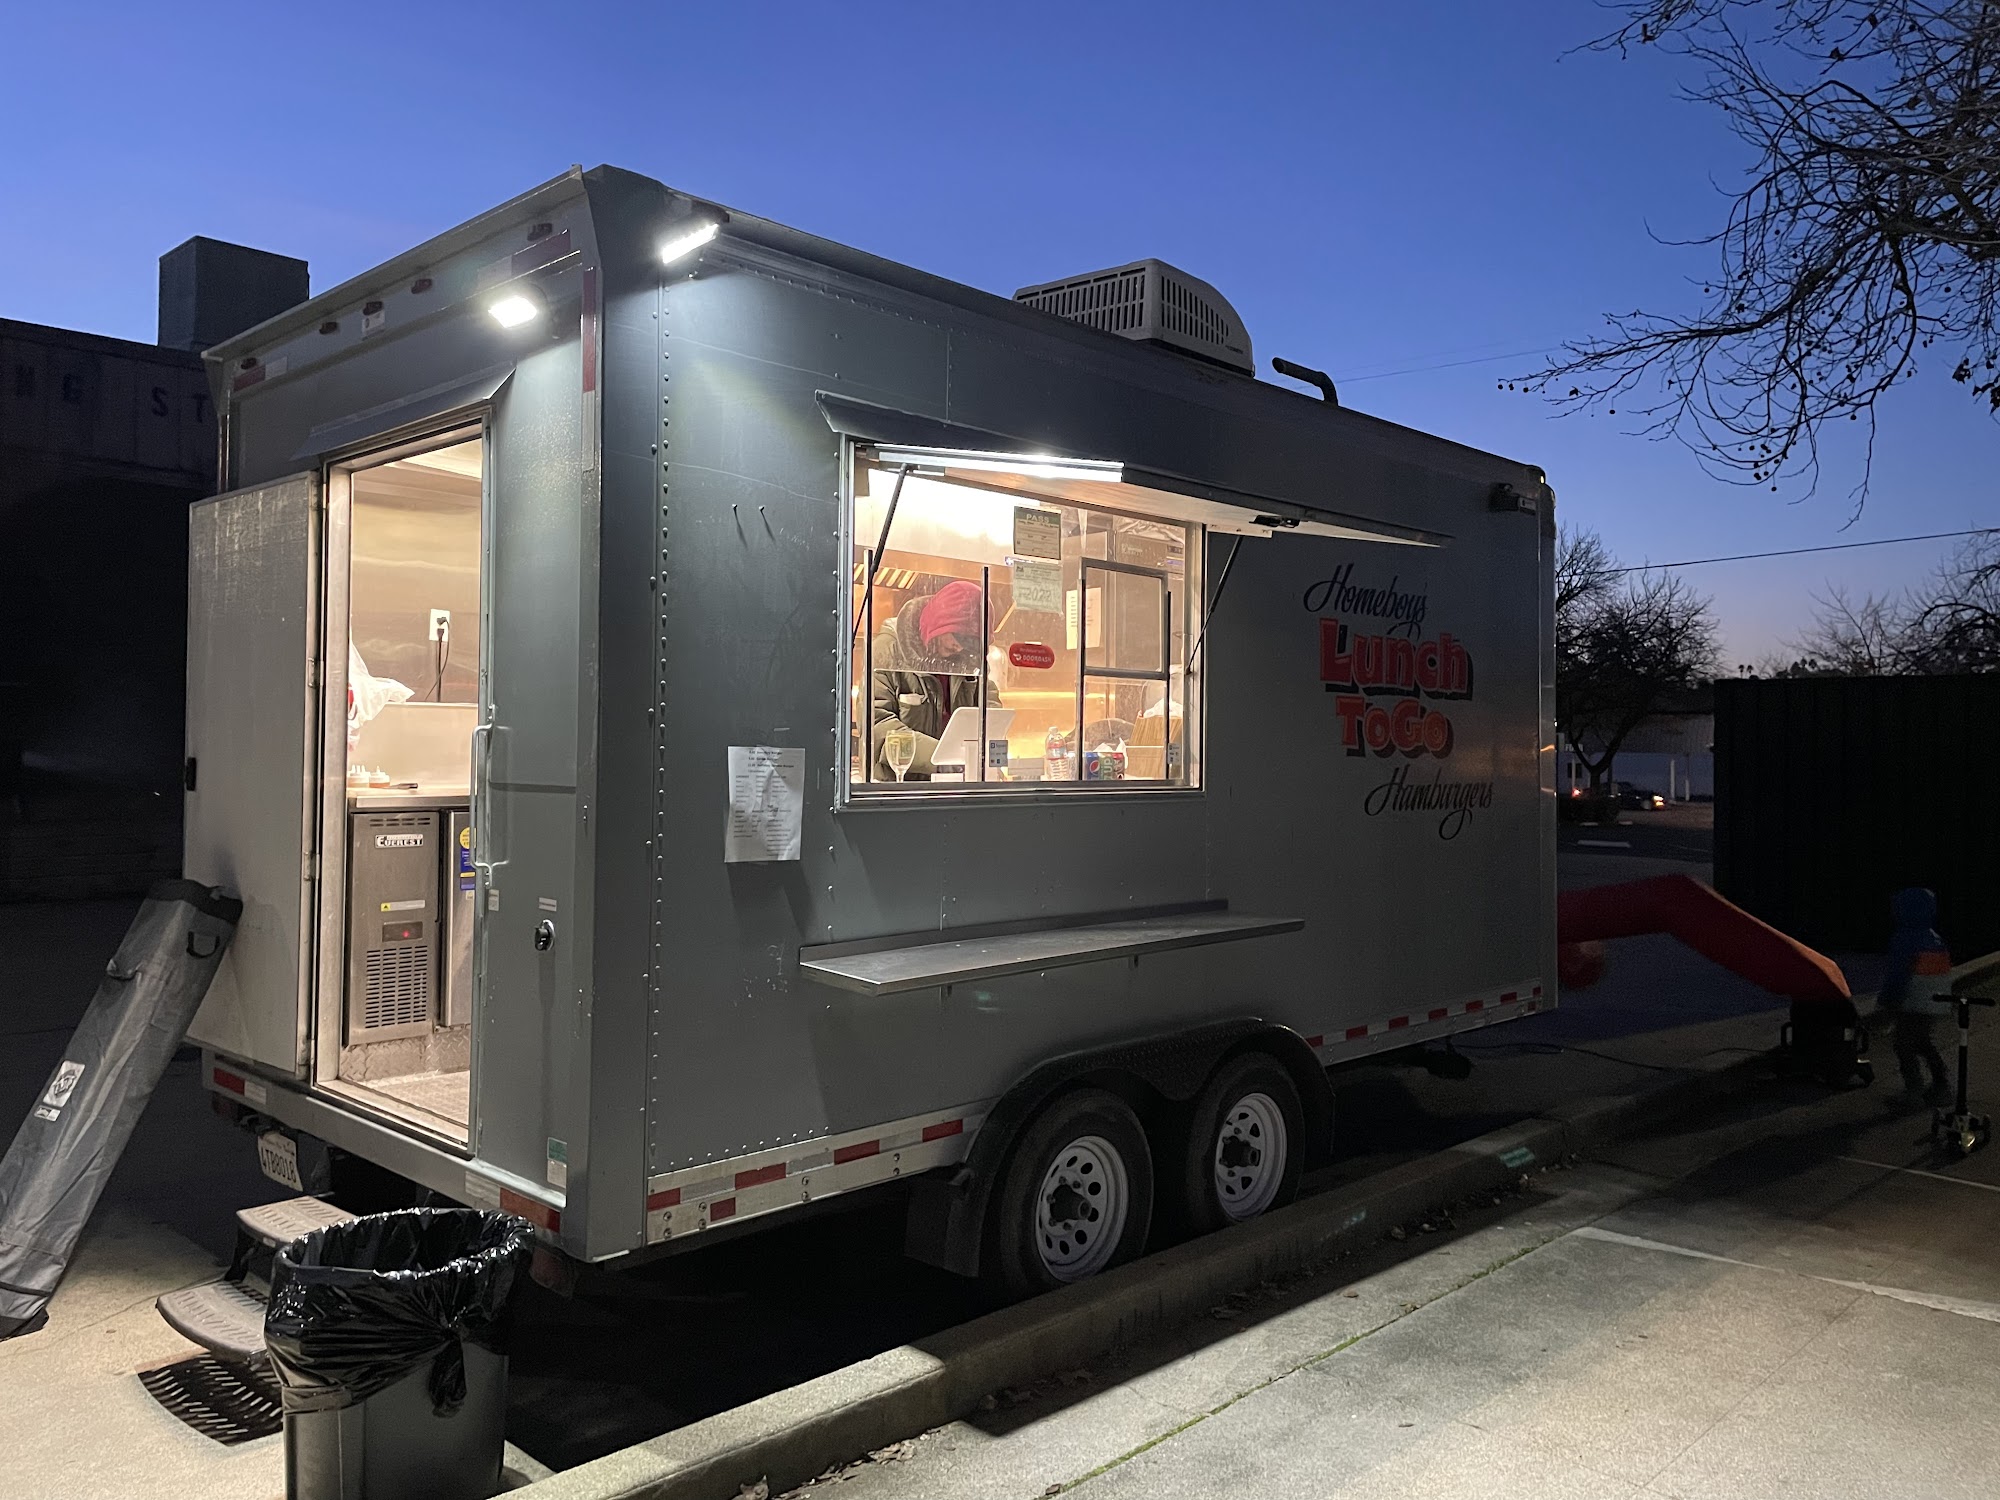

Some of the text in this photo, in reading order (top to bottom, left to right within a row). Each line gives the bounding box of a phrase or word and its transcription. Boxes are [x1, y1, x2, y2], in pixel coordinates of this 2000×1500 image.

[1026, 513, 1050, 524] PASS
[1319, 617, 1472, 698] Lunch
[1365, 764, 1494, 840] Hamburgers
